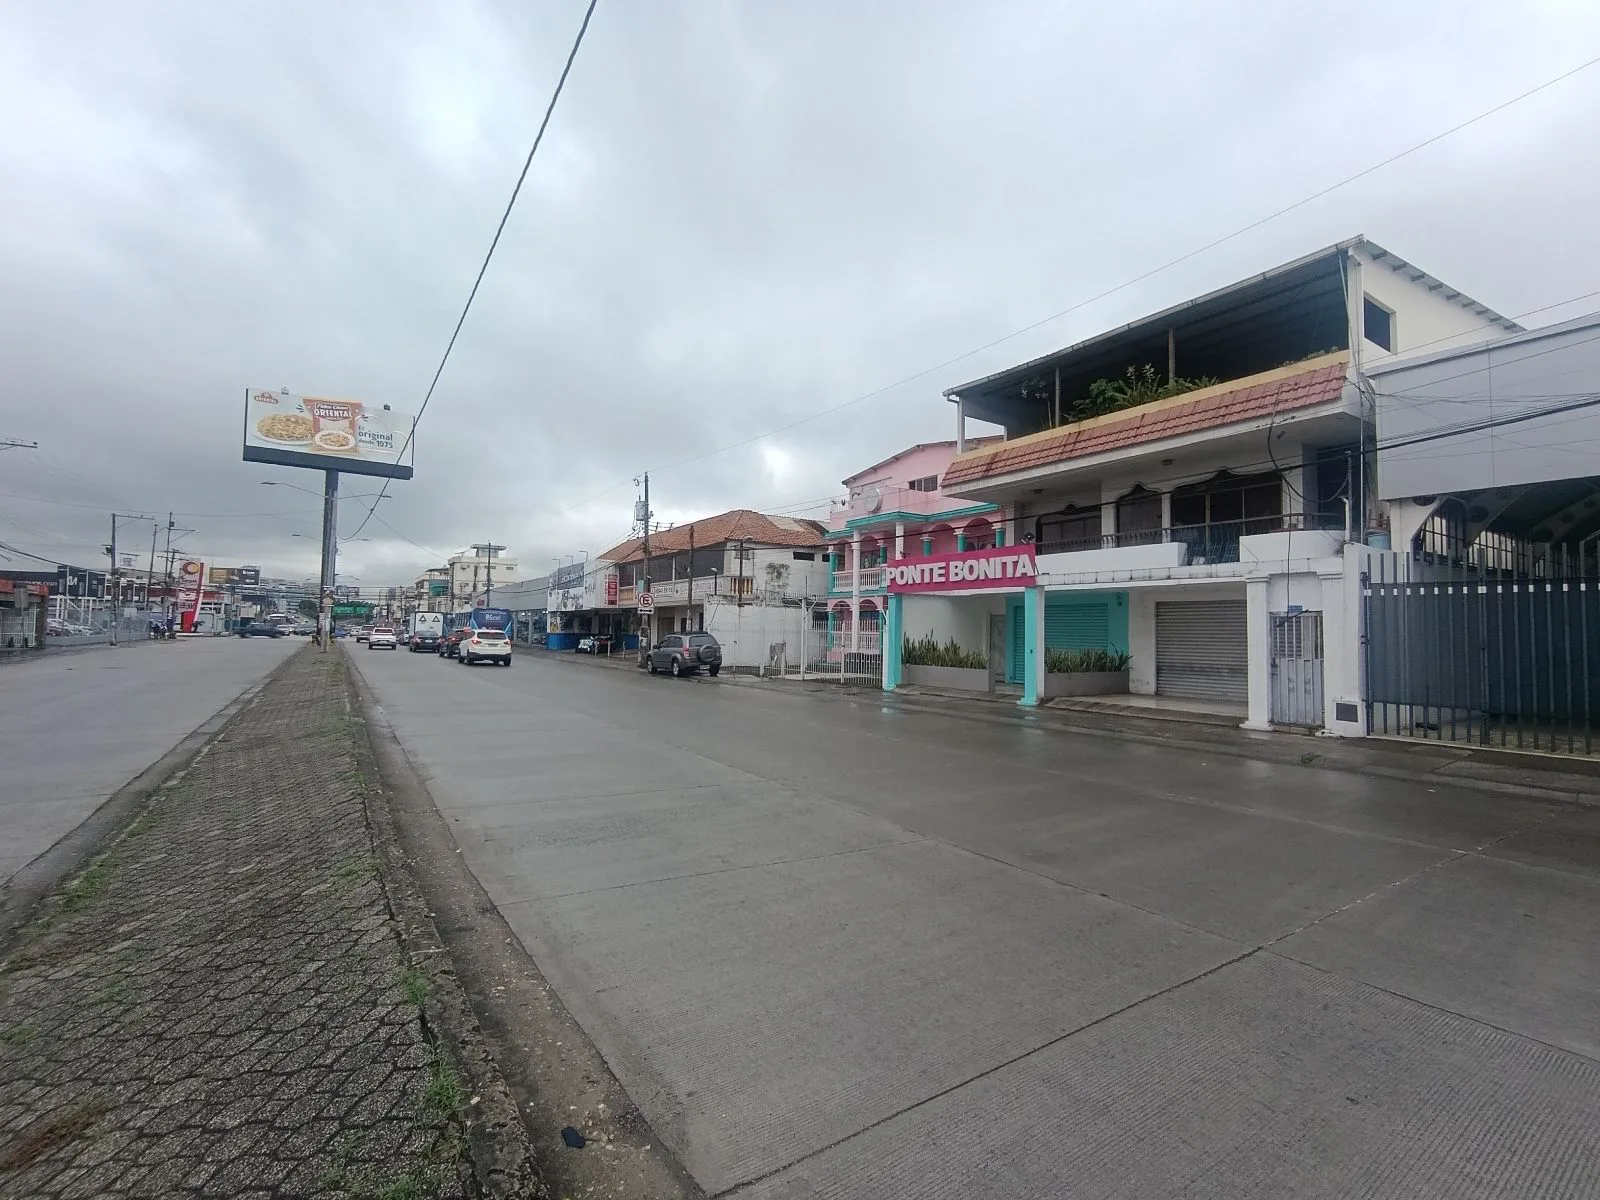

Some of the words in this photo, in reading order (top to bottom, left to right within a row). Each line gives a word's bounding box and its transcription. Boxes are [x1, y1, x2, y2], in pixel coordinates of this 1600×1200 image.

[314, 408, 352, 417] ORIENTAL
[358, 430, 393, 442] original
[376, 440, 393, 448] 1975
[887, 562, 946, 585] PONTE
[949, 554, 1035, 582] BONITA
